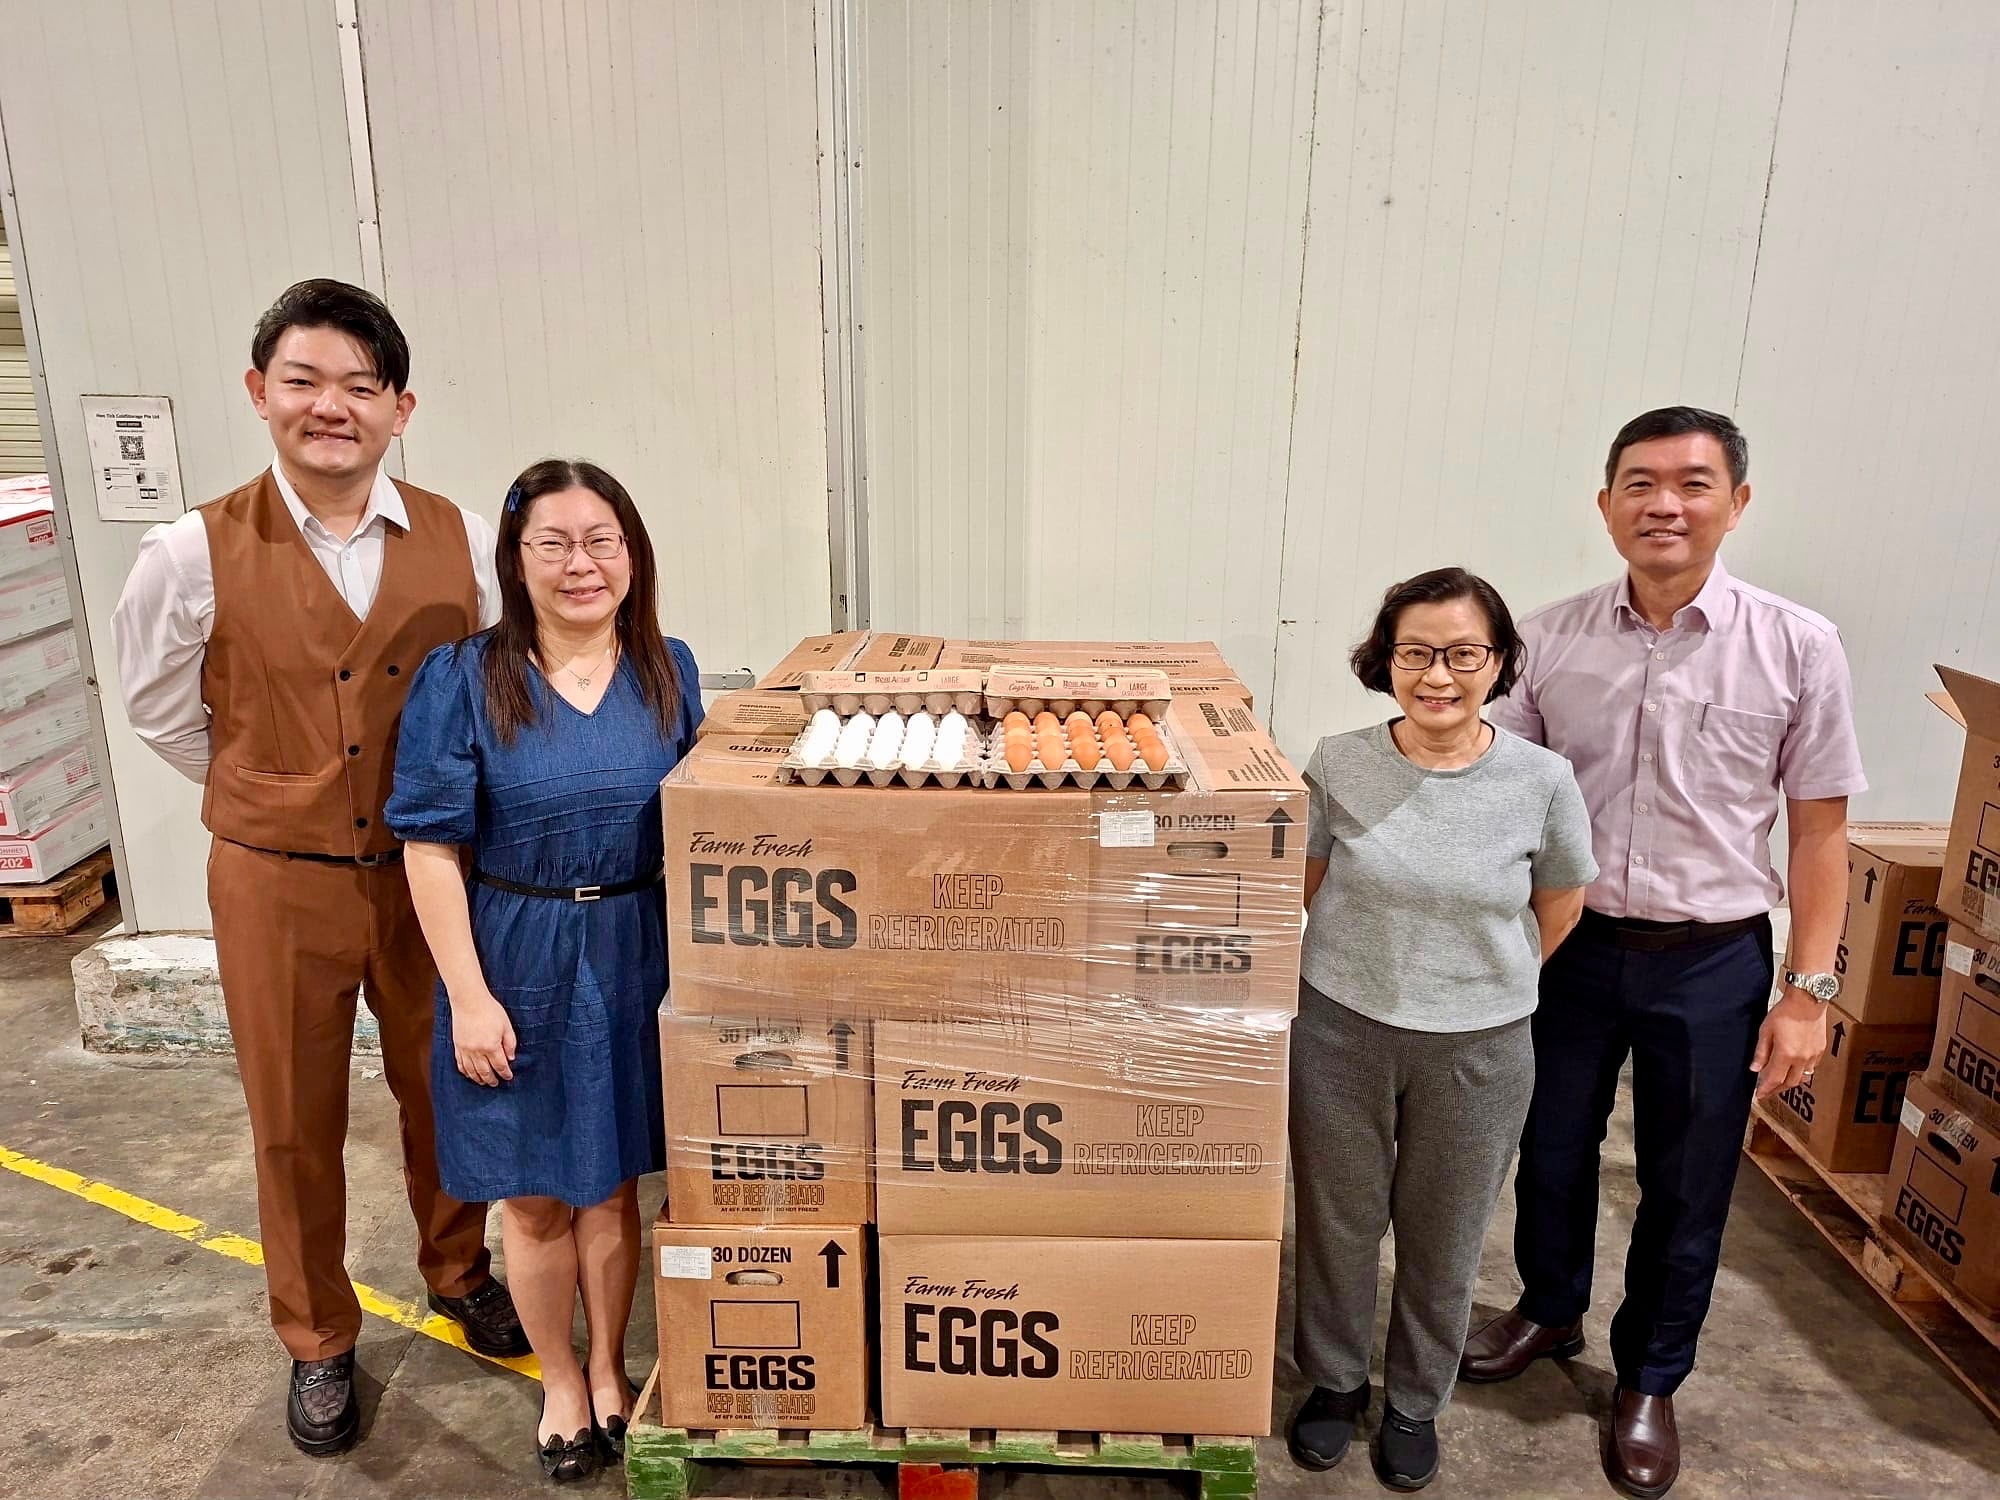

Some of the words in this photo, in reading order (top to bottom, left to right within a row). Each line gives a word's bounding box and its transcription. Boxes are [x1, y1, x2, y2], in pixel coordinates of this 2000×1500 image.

[1129, 682, 1147, 691] LARGE
[1178, 815, 1235, 831] DOZEN
[690, 831, 746, 855] Farm
[752, 834, 814, 857] Fresh
[1965, 850, 2000, 896] EG
[690, 863, 857, 949] EGGS
[933, 874, 1004, 910] KEEP
[868, 914, 1065, 952] REFRIGERATED
[1135, 935, 1252, 974] EGGS
[1973, 949, 1988, 965] 30
[901, 1070, 957, 1090] Farm
[962, 1072, 1022, 1092] Fresh
[1136, 1105, 1204, 1137] KEEP
[1928, 1108, 1944, 1125] 30
[901, 1099, 1063, 1174] EGGS
[711, 1142, 825, 1180] EGGS
[1073, 1143, 1262, 1175] REFRIGERATED
[713, 1184, 741, 1205] KEEP
[743, 1184, 825, 1206] REFRIGERATED
[1894, 1185, 1966, 1265] EGGS
[712, 1247, 732, 1262] 30
[738, 1247, 792, 1263] DOZEN
[904, 1276, 957, 1297] Farm
[962, 1279, 1020, 1300] Fresh
[904, 1302, 1060, 1379] EGGS
[1130, 1314, 1197, 1345] KEEP
[705, 1354, 816, 1390] EGGS
[1069, 1349, 1253, 1381] REFRIGERATED
[707, 1393, 733, 1413] KEEP
[736, 1393, 816, 1414] REFRIGERATED
